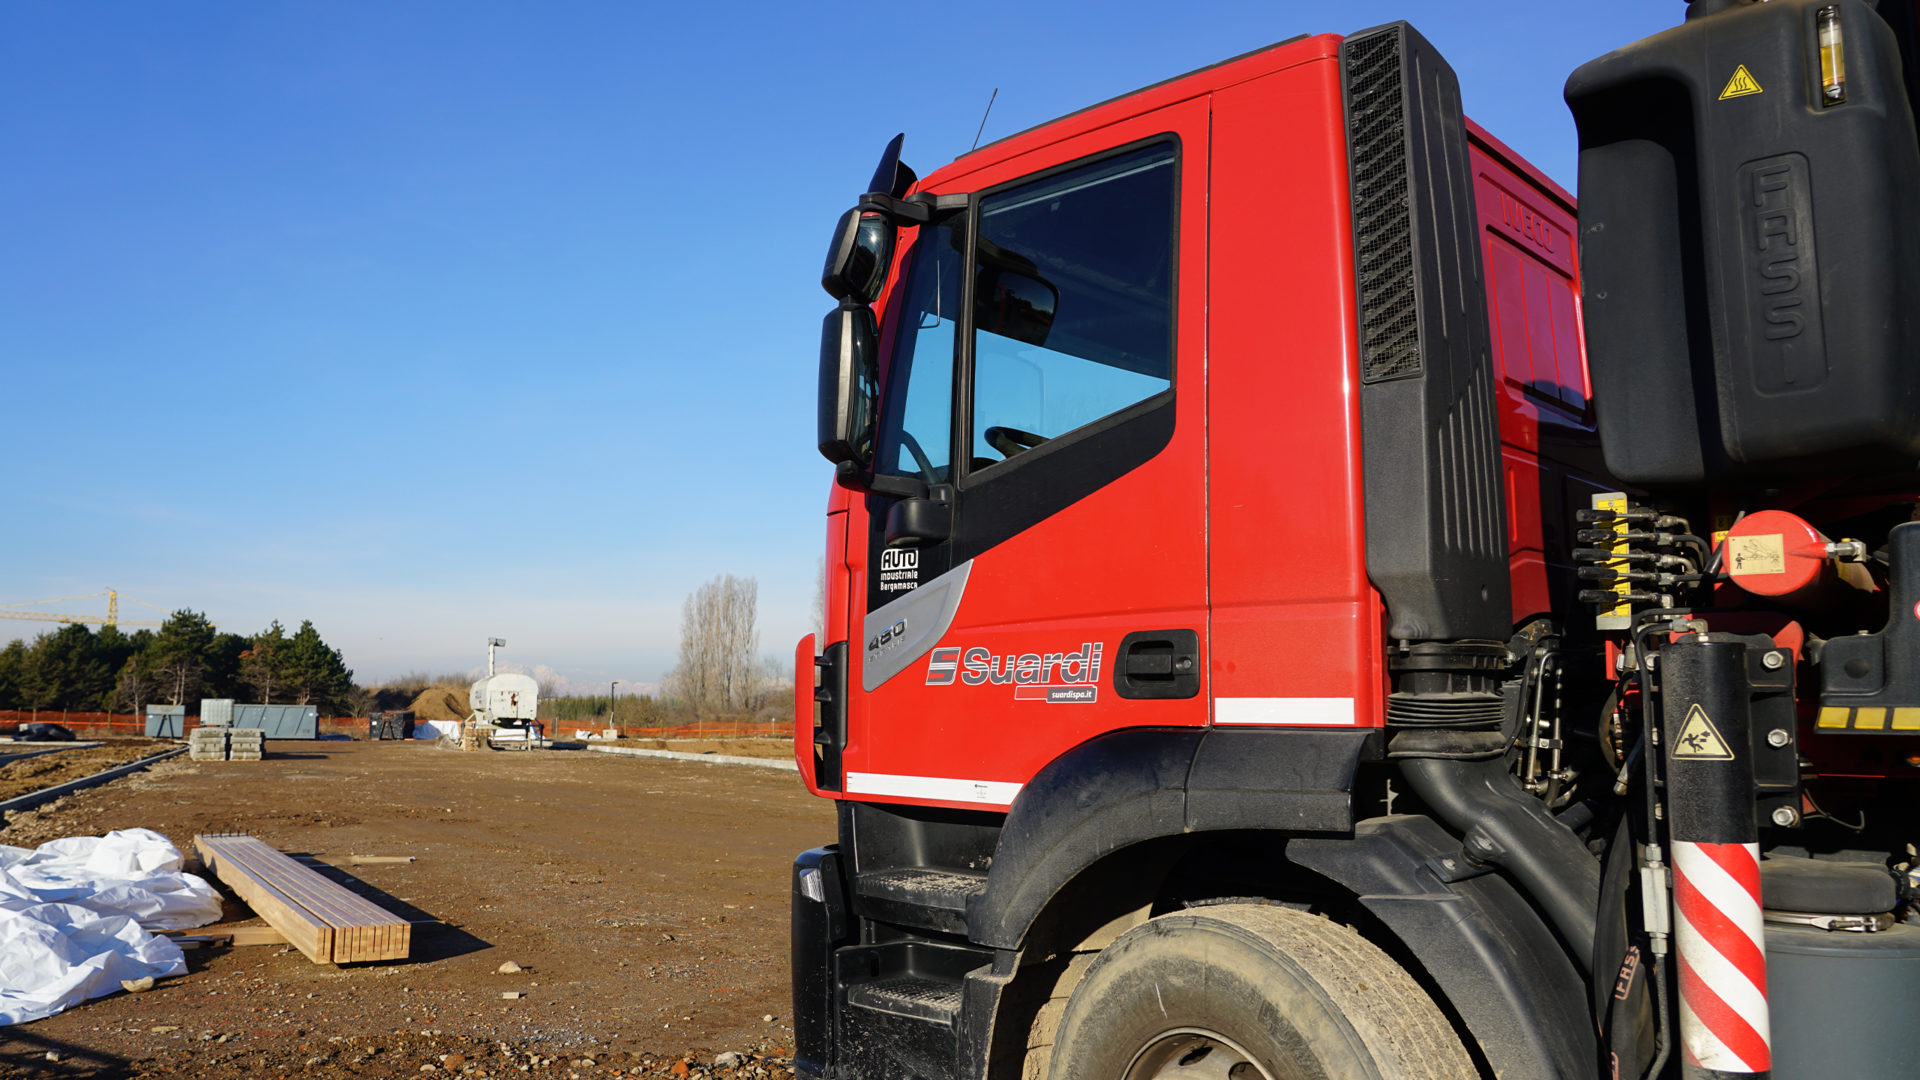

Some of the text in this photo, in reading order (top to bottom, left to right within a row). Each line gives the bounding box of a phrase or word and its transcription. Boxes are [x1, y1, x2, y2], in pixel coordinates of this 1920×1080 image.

[1751, 163, 1805, 385] FASSI
[882, 549, 918, 569] AUTO
[961, 642, 1104, 686] Suardi
[1051, 690, 1092, 700] suardispa.it
